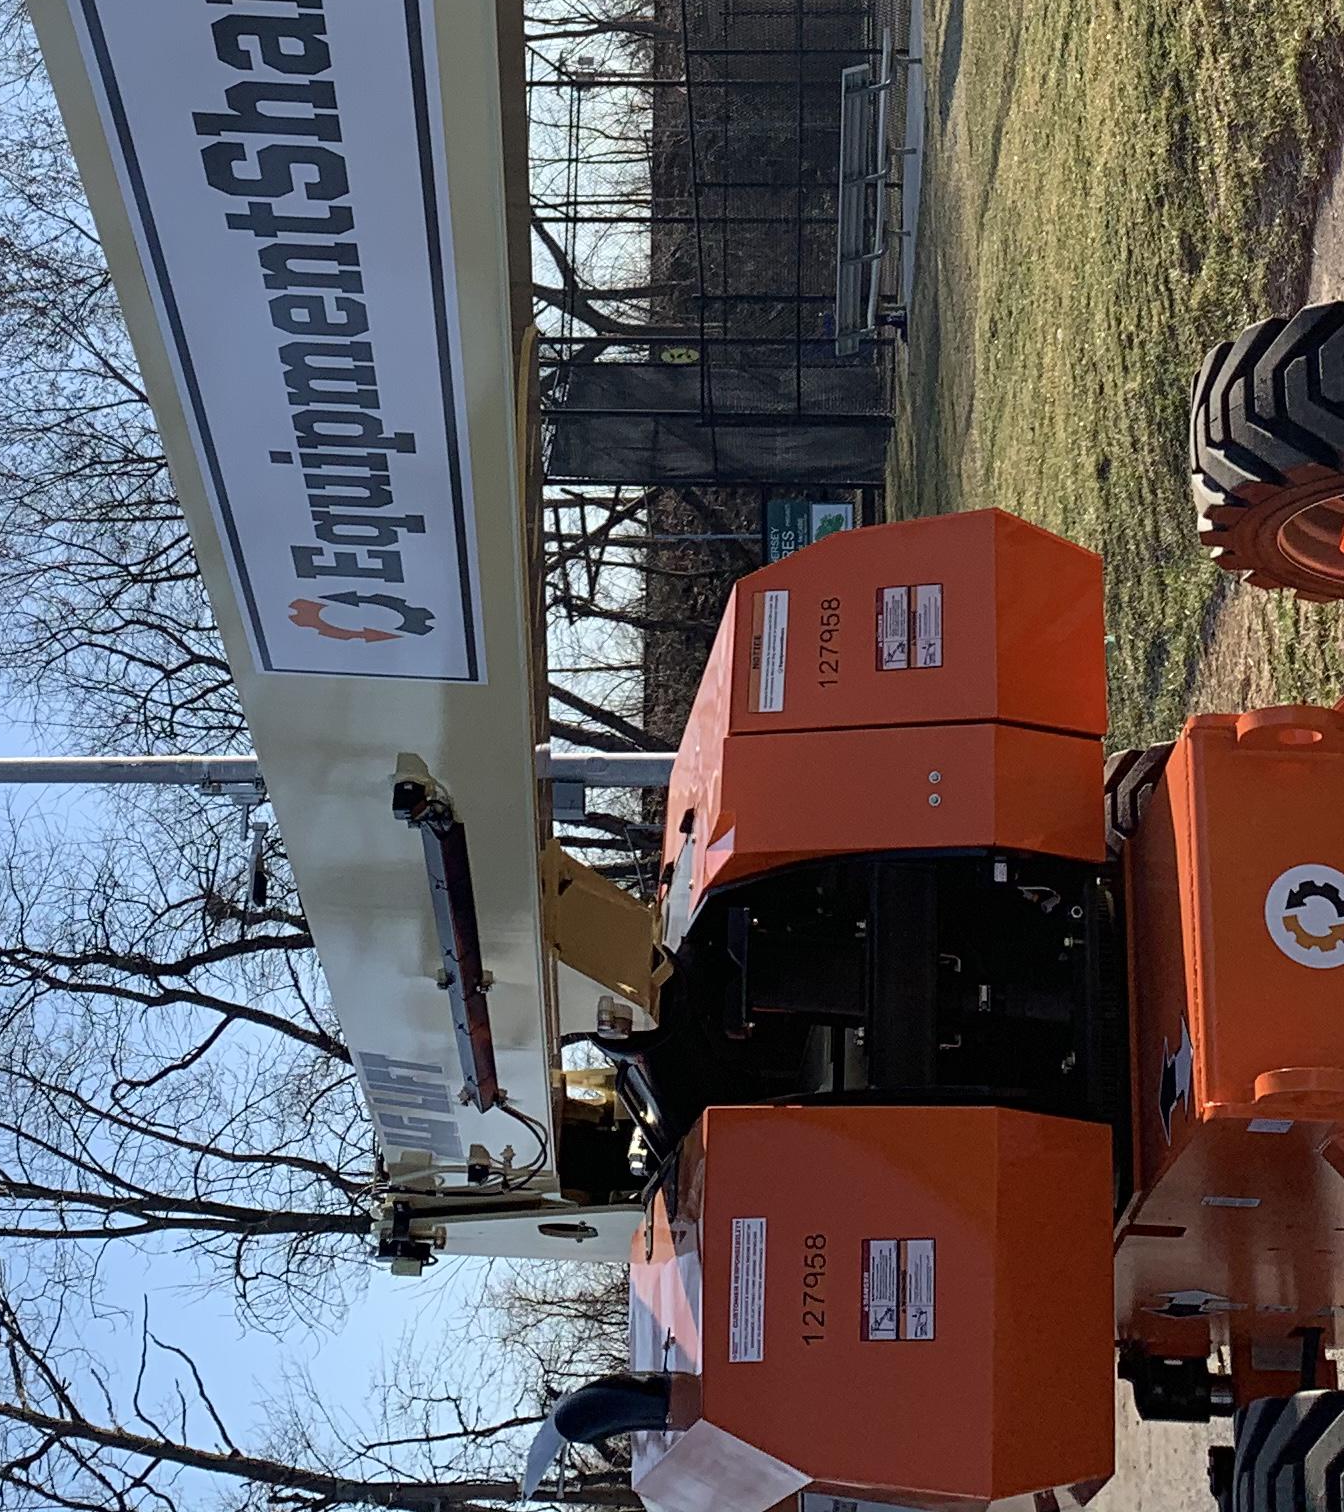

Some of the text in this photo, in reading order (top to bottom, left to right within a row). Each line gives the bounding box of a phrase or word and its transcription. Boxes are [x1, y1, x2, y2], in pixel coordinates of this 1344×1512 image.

[770, 526, 780, 562] ERSEY
[782, 530, 795, 559] RES
[752, 634, 762, 670] NOTICE
[818, 597, 840, 688] 127958
[358, 1051, 450, 1114] LIFT
[802, 1234, 826, 1346] 127958
